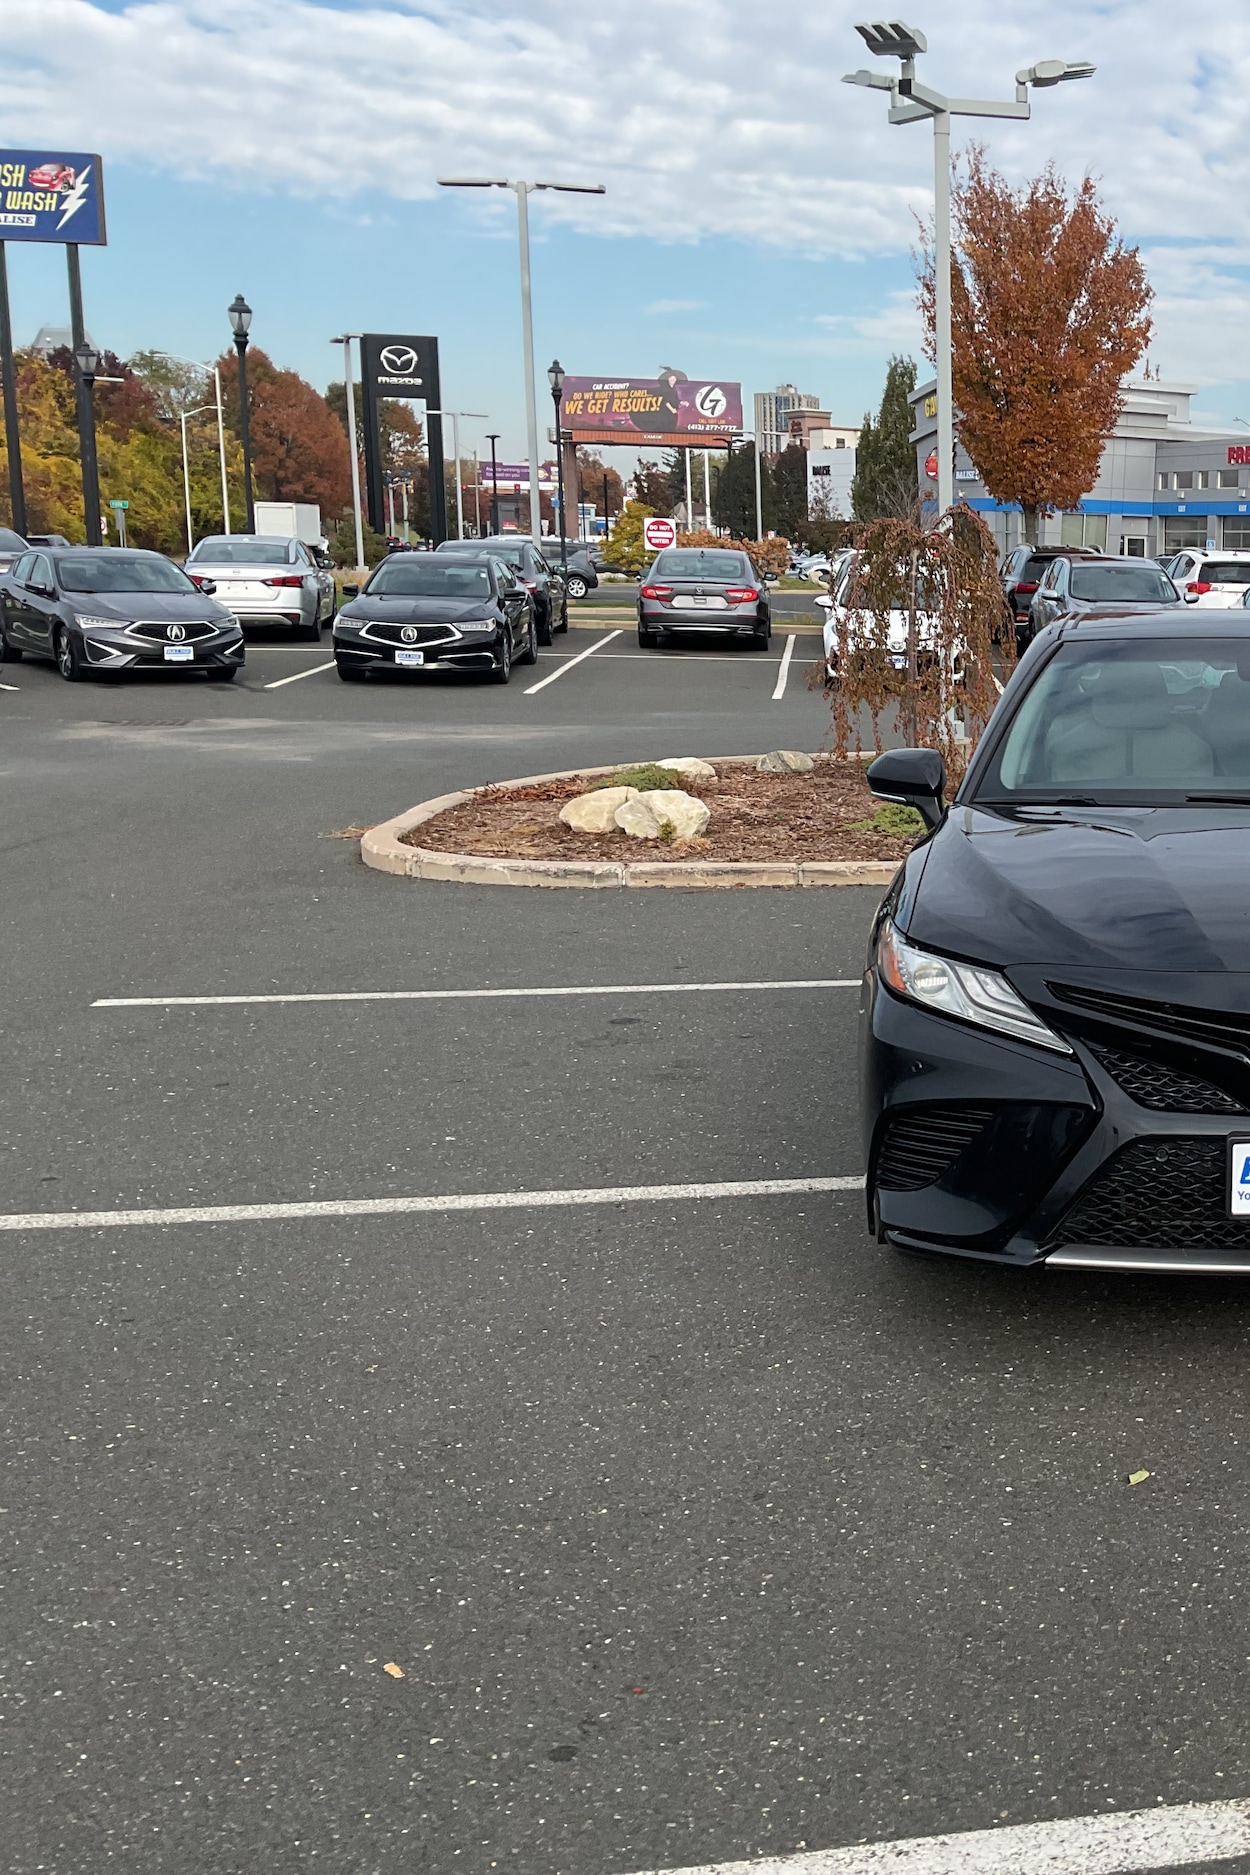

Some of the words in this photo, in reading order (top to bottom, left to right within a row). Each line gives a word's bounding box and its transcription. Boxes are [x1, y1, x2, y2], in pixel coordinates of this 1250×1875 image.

[0, 164, 25, 187] SH
[6, 191, 57, 211] WASH
[377, 376, 423, 386] mazda
[603, 382, 630, 390] ACCIDENT?
[573, 392, 581, 400] DO
[583, 391, 593, 399] WE
[595, 391, 612, 399] RIDE?
[614, 390, 628, 398] WHO
[565, 401, 584, 414] WE
[587, 399, 609, 414] GET
[612, 396, 663, 412] RESULTS!
[955, 470, 976, 480] BALISE
